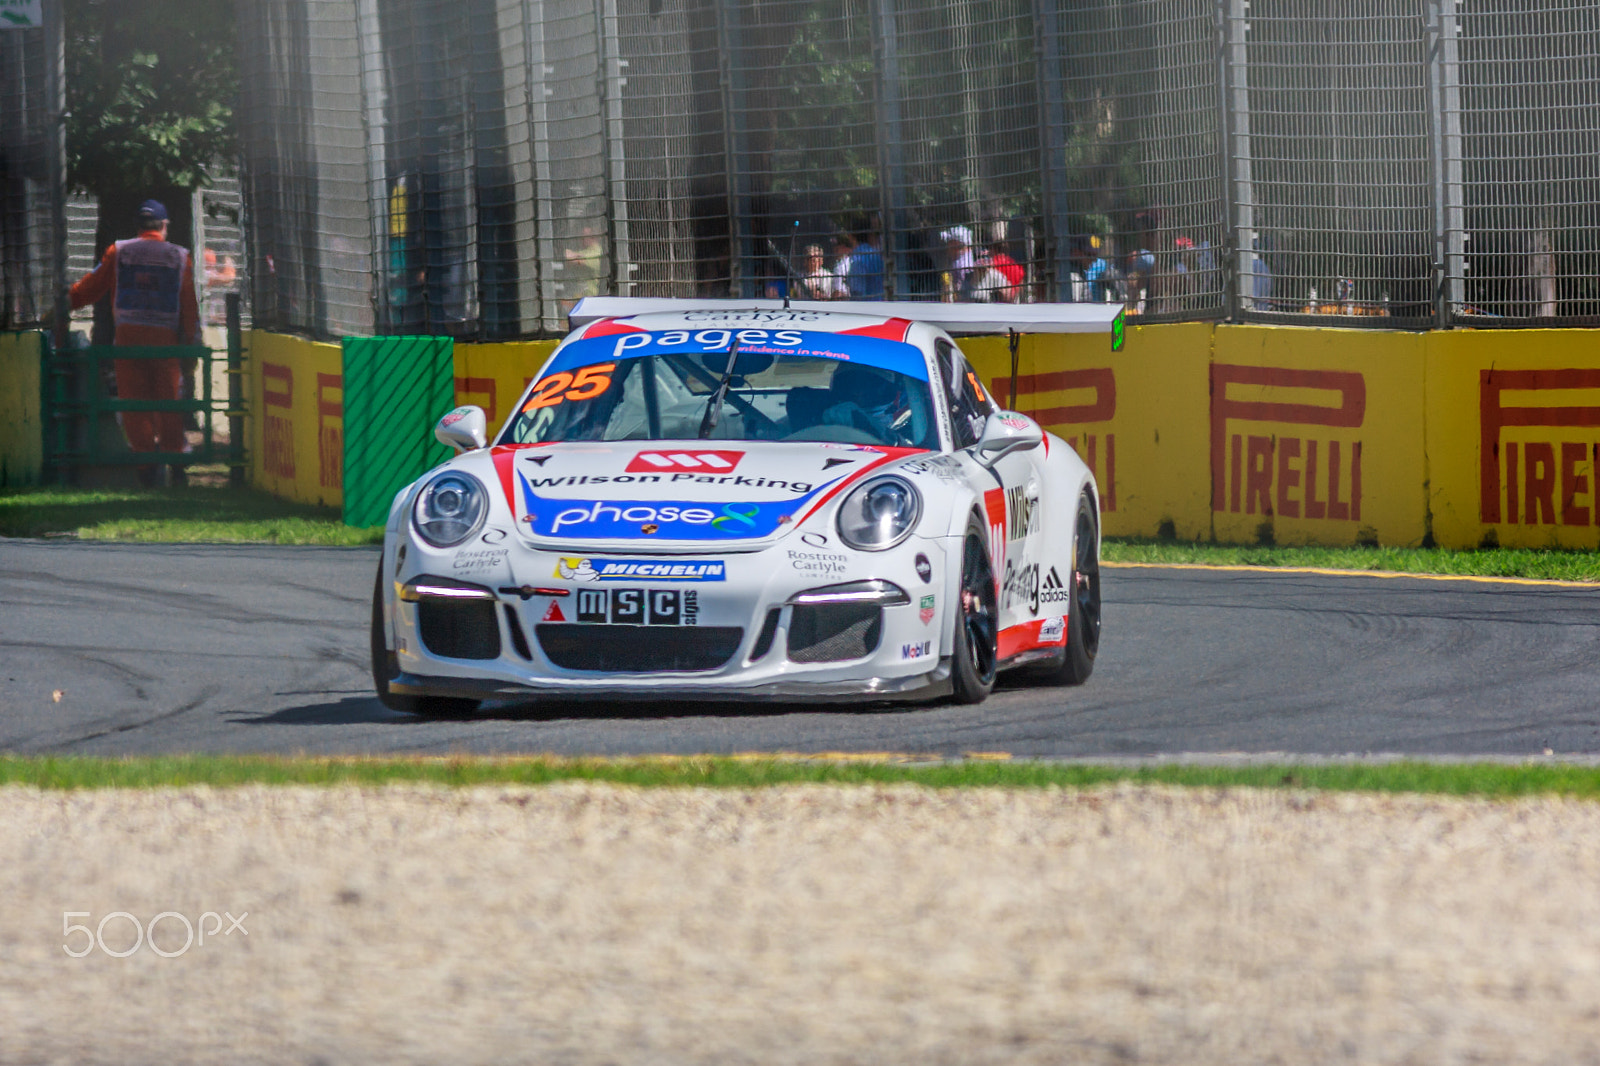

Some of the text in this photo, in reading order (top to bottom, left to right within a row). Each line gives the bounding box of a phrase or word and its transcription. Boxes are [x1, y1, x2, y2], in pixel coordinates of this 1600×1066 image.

[684, 312, 819, 323] Carlyle
[613, 329, 803, 357] pages
[726, 345, 795, 355] cnfidence
[811, 350, 850, 360] events
[522, 363, 616, 413] 25
[1209, 363, 1366, 521] PIRELLI
[1480, 369, 1600, 526] PIRE
[530, 473, 813, 493] Wilson Parking
[787, 550, 848, 562] Rostron
[601, 563, 723, 576] MICHELIN
[792, 560, 846, 574] Carlyle
[1040, 587, 1068, 603] adidas
